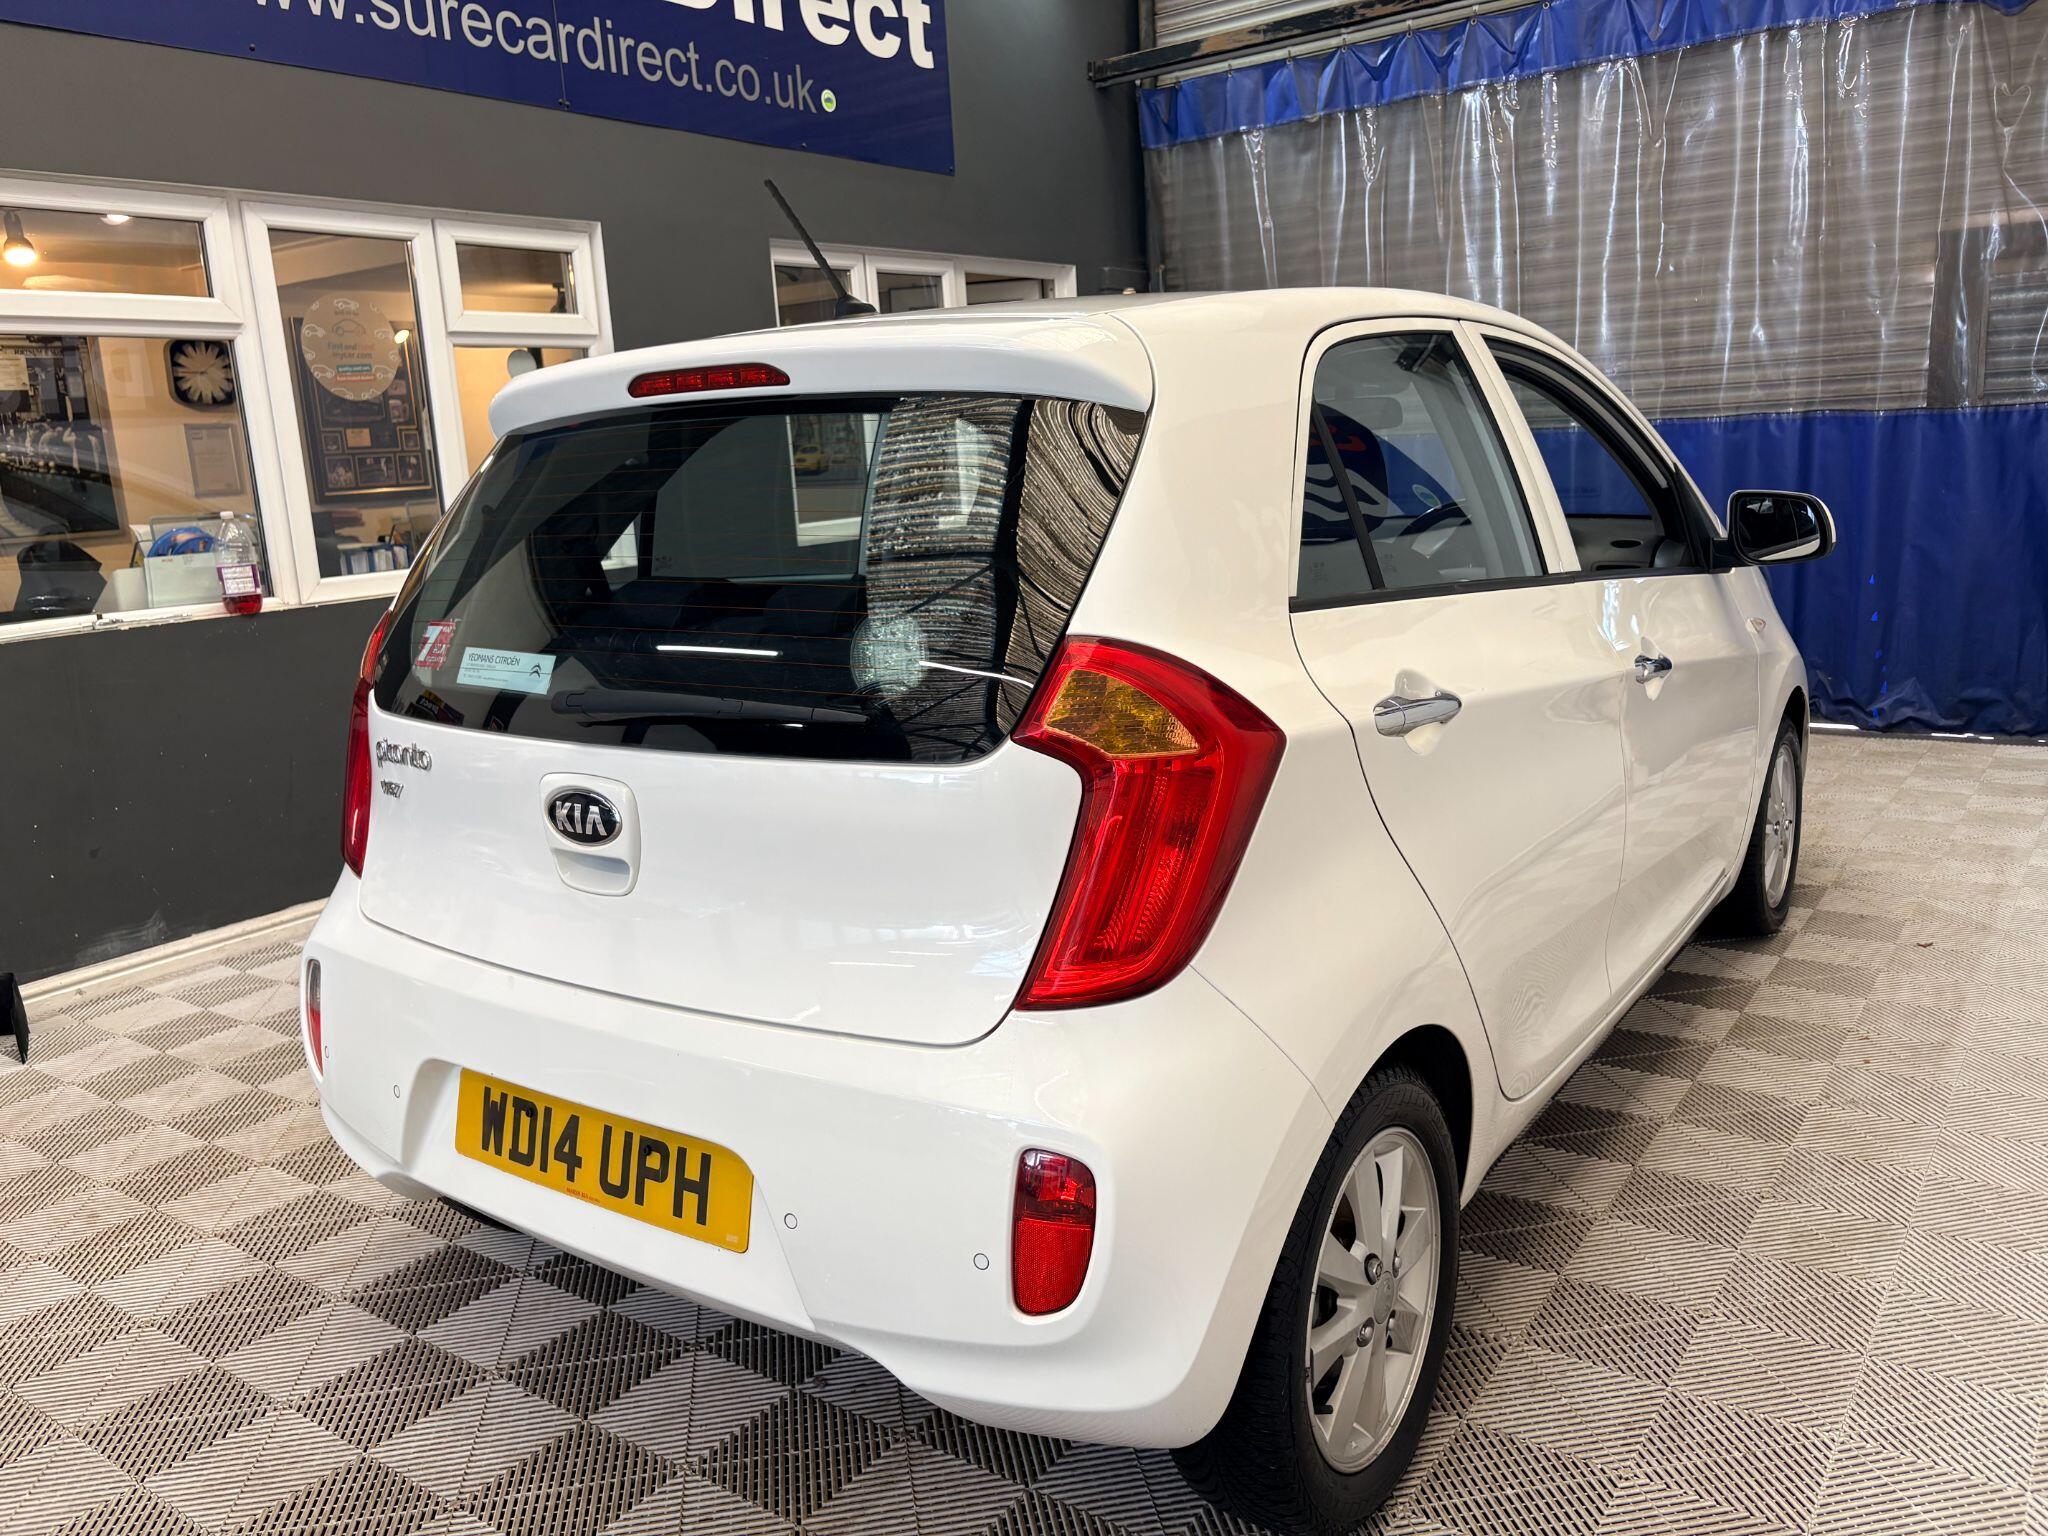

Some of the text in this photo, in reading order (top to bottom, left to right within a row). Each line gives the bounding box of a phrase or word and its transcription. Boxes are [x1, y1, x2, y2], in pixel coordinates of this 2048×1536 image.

[256, 0, 817, 113] w.surecardirect.co.uk
[661, 0, 934, 69] ect
[468, 652, 495, 664] YEOMANS
[554, 800, 608, 836] KIA
[481, 1086, 712, 1226] WD14 UPH
